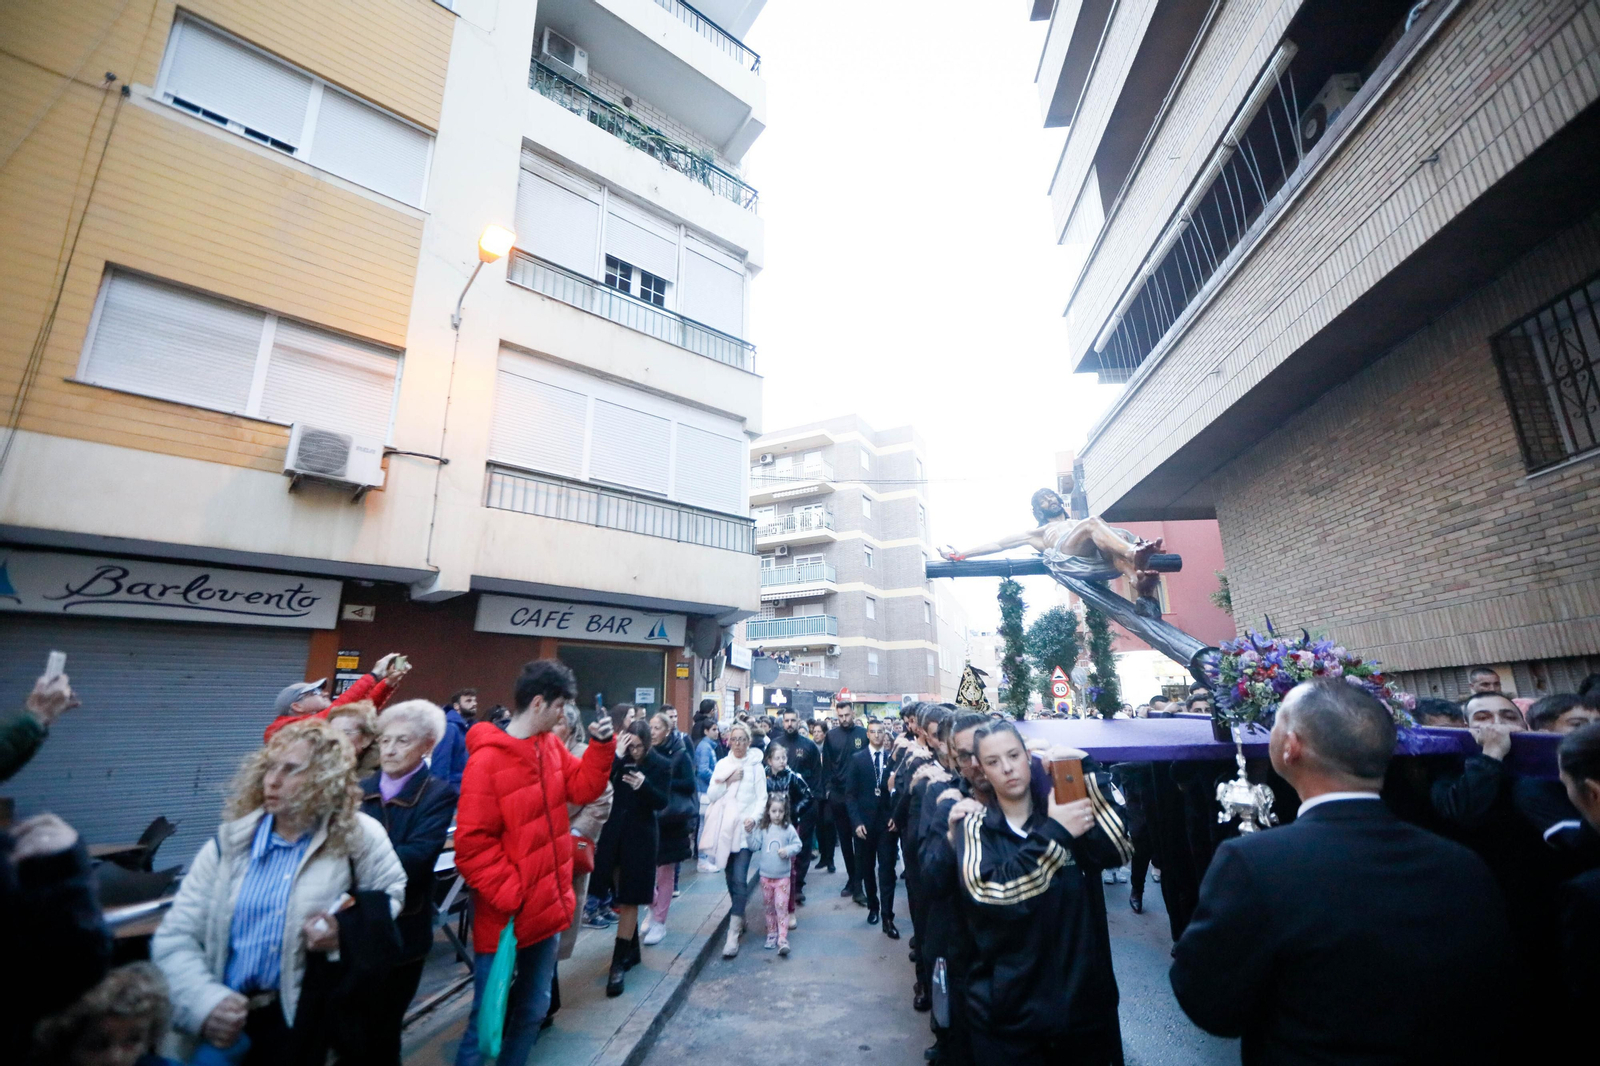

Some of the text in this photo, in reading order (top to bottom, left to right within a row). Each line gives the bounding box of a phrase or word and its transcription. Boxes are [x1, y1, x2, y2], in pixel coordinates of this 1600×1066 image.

[44, 564, 321, 612] Barlovento
[510, 606, 633, 635] CAFÉ BAR
